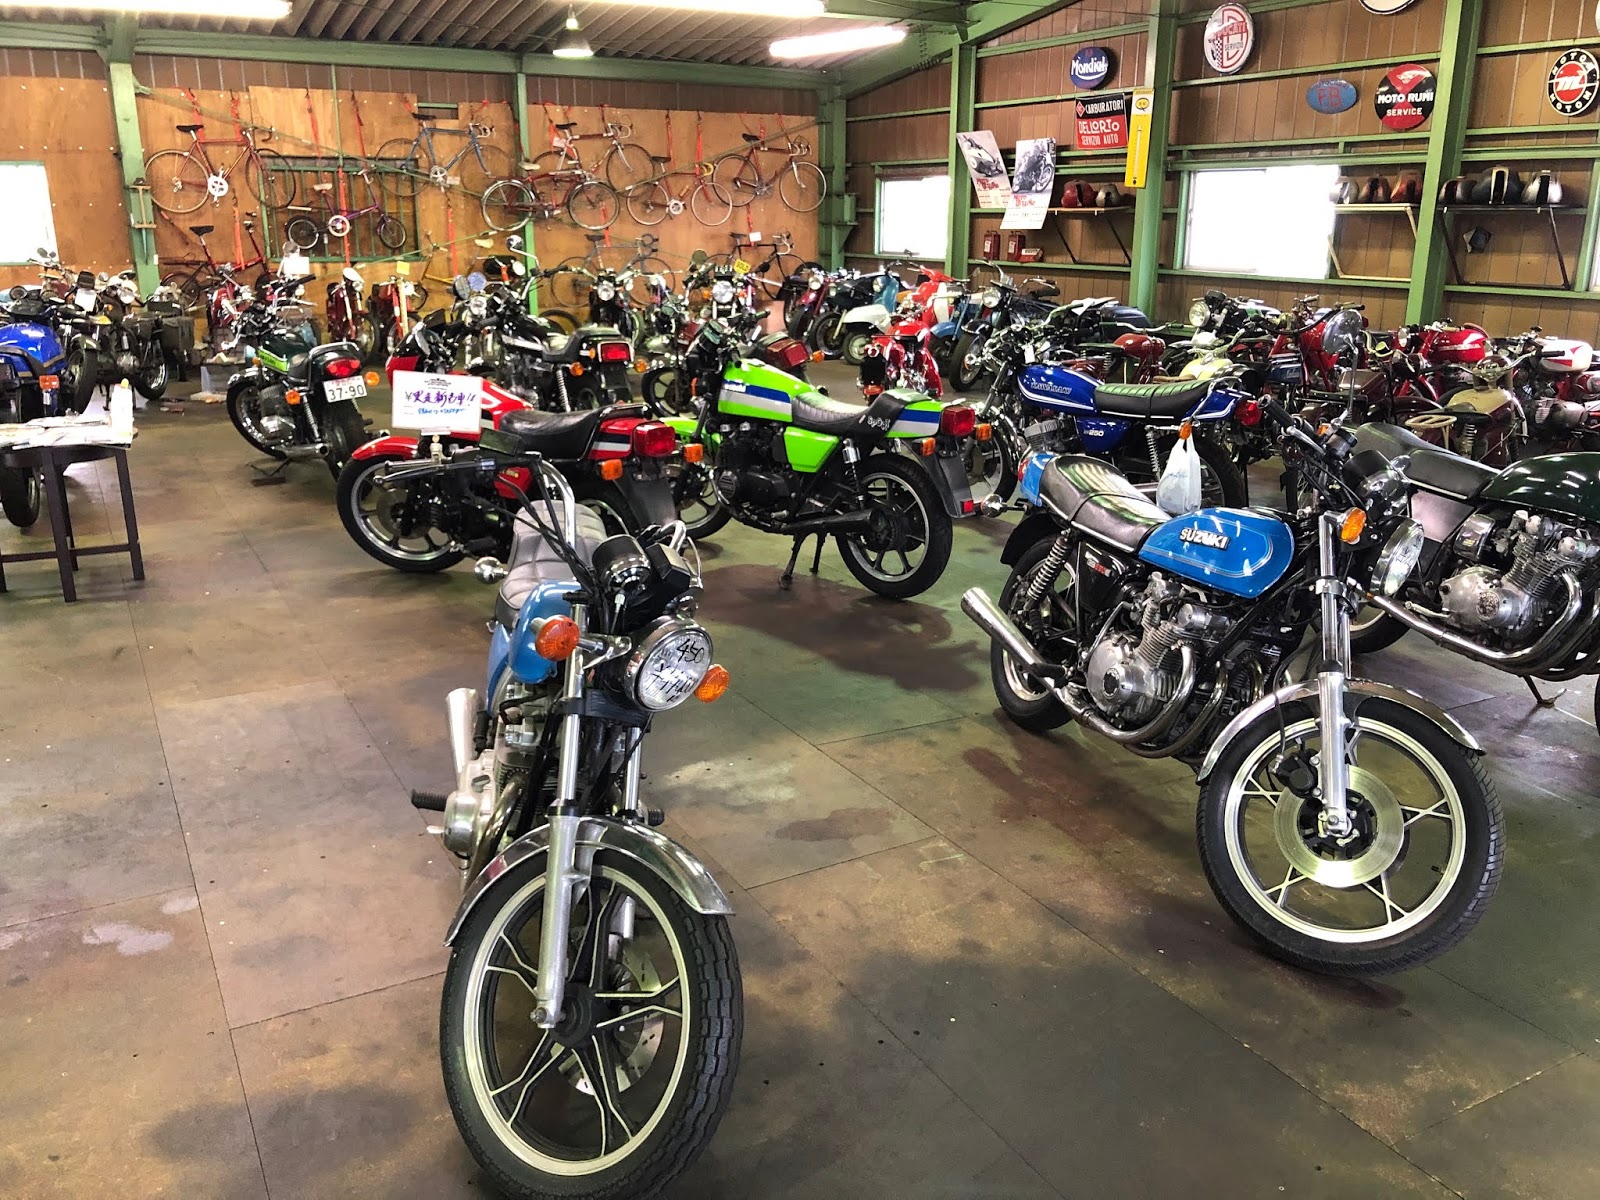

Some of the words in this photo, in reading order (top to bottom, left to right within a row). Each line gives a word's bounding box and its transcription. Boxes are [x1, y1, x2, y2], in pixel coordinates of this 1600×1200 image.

[1215, 22, 1247, 37] DUCATI
[1225, 42, 1244, 51] SERVIZIO
[1317, 86, 1342, 107] FB
[1377, 93, 1406, 104] MOTO
[1407, 92, 1434, 103] RUMI
[1550, 90, 1592, 113] MOTOM
[1085, 99, 1124, 115] CARBURATORI
[1386, 107, 1423, 117] SERVICE
[1081, 135, 1101, 146] SERVIZIO
[1103, 133, 1119, 145] AUTO
[328, 384, 365, 401] 37-90
[1180, 528, 1229, 549] SUZUKI
[677, 638, 704, 663] 450
